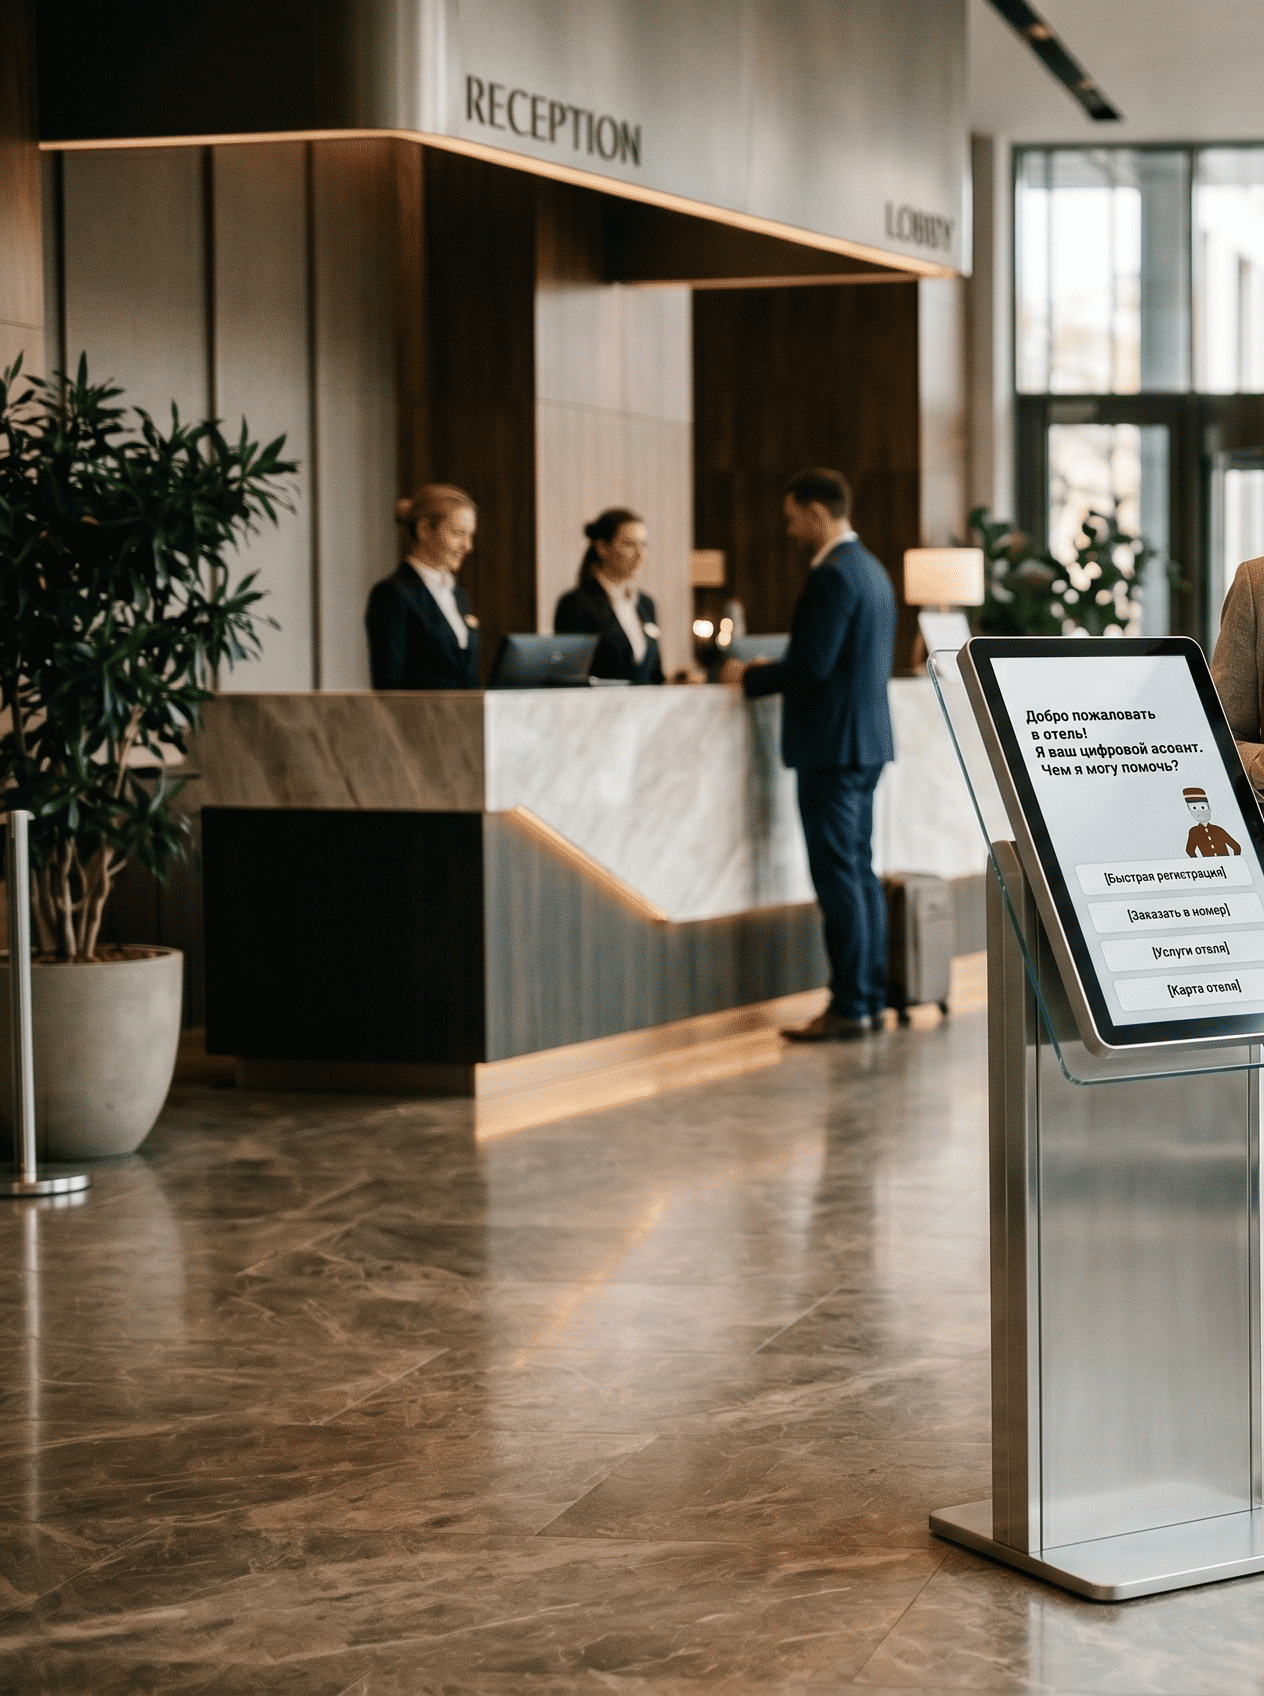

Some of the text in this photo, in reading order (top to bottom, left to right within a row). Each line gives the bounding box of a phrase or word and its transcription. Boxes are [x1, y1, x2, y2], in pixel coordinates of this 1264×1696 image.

[466, 74, 642, 168] RECEPTION
[1026, 710, 1156, 724] Добро пожаловать
[1031, 728, 1088, 740] в отель!
[1035, 746, 1045, 758] Я
[1049, 749, 1077, 758] ваш
[1080, 742, 1148, 758] цифровой
[1041, 759, 1179, 777] Чем я могу помочь?
[1104, 872, 1155, 886] [Быстрая
[1183, 909, 1190, 917] в
[1192, 903, 1231, 917] номер]
[1167, 984, 1204, 998] [Карта
